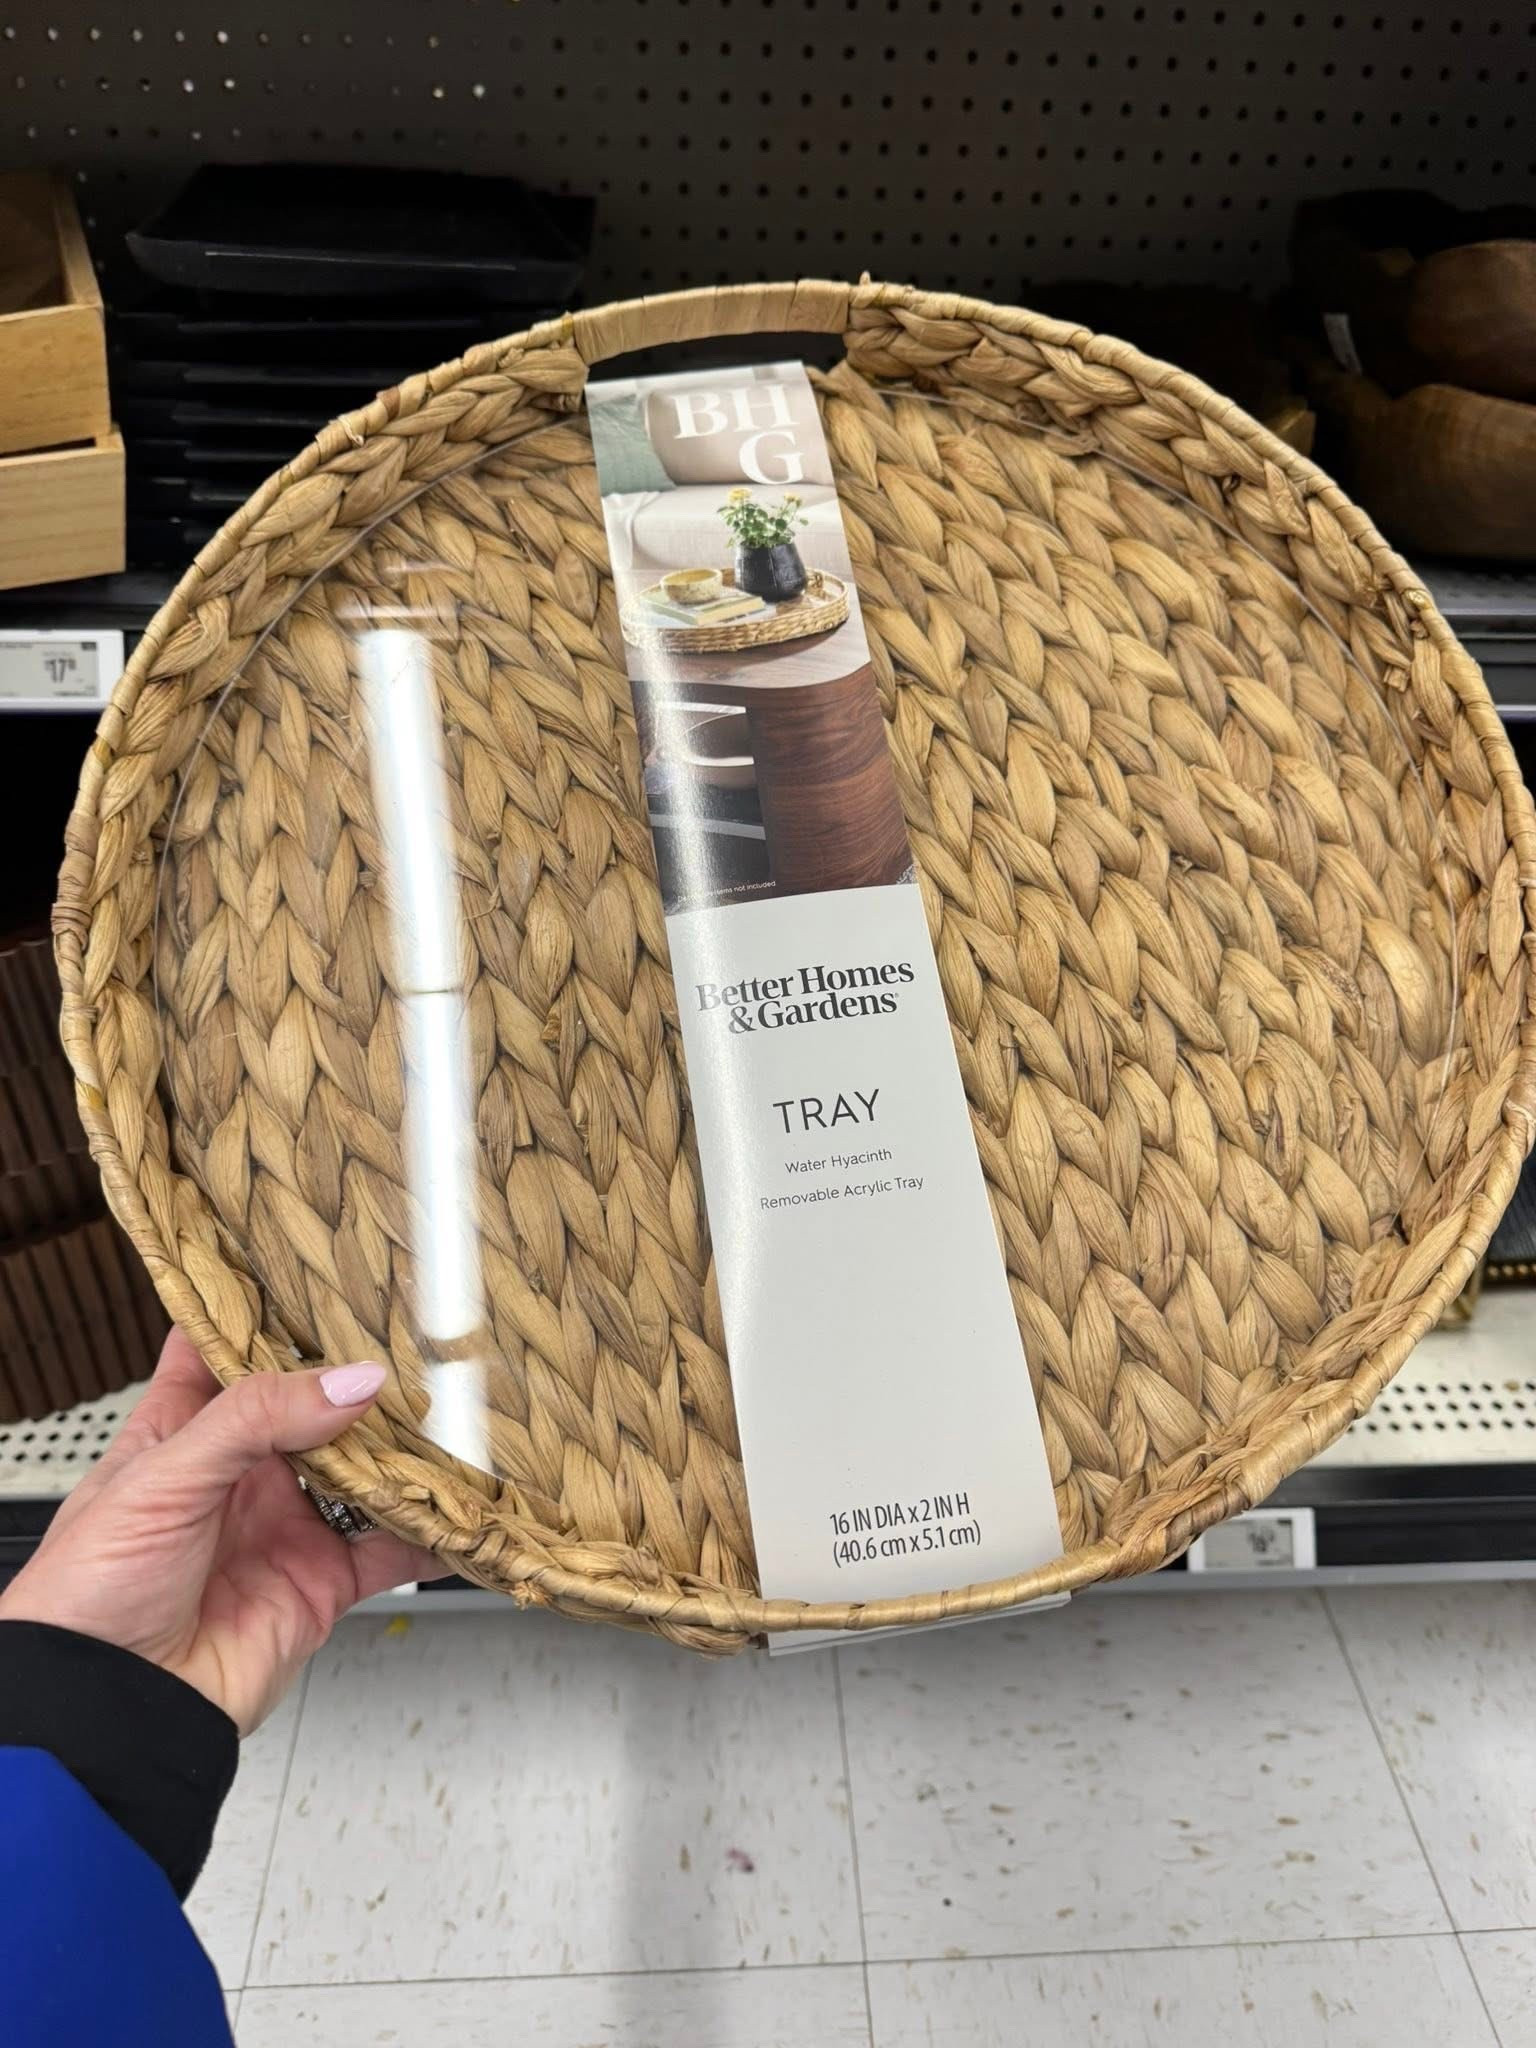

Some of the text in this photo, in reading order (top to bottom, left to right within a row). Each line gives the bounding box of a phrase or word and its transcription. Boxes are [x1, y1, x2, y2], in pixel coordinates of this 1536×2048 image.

[672, 383, 801, 440] BH
[738, 430, 804, 485] G
[733, 884, 747, 892] not
[746, 880, 777, 890] included
[695, 962, 915, 1011] Better Homes
[728, 1005, 758, 1034] &
[772, 1088, 880, 1134] TRAY
[784, 1148, 893, 1174] Water Hyacinth
[760, 1176, 924, 1210] Removable Acrylic Tray
[829, 1492, 971, 1536] 16 IN DIA x 2 IN H
[832, 1519, 982, 1569] (40.6 cm x 5.1 cm)
